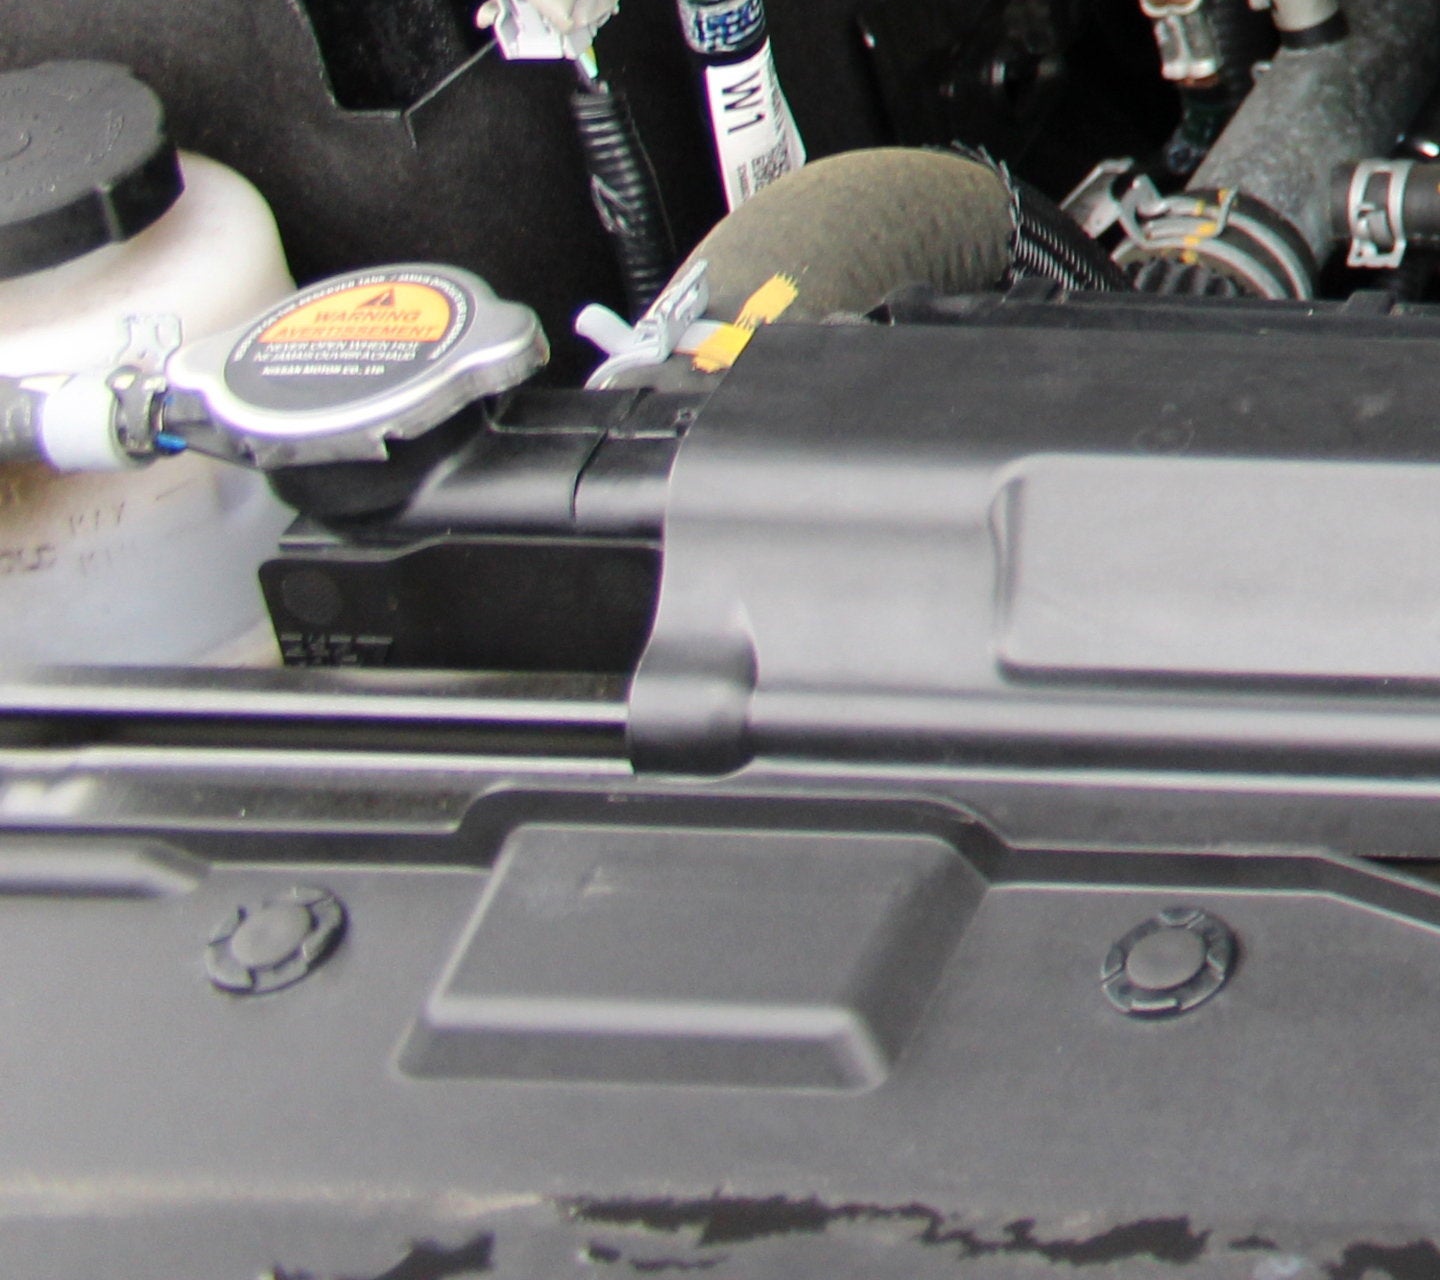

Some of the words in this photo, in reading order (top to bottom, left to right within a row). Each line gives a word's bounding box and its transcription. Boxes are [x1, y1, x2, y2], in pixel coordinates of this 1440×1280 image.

[720, 69, 766, 135] W1
[314, 309, 422, 323] WARNING
[274, 325, 438, 339] AVERTISSEMENT
[261, 364, 302, 376] NISSAN
[302, 364, 342, 376] MOTOR
